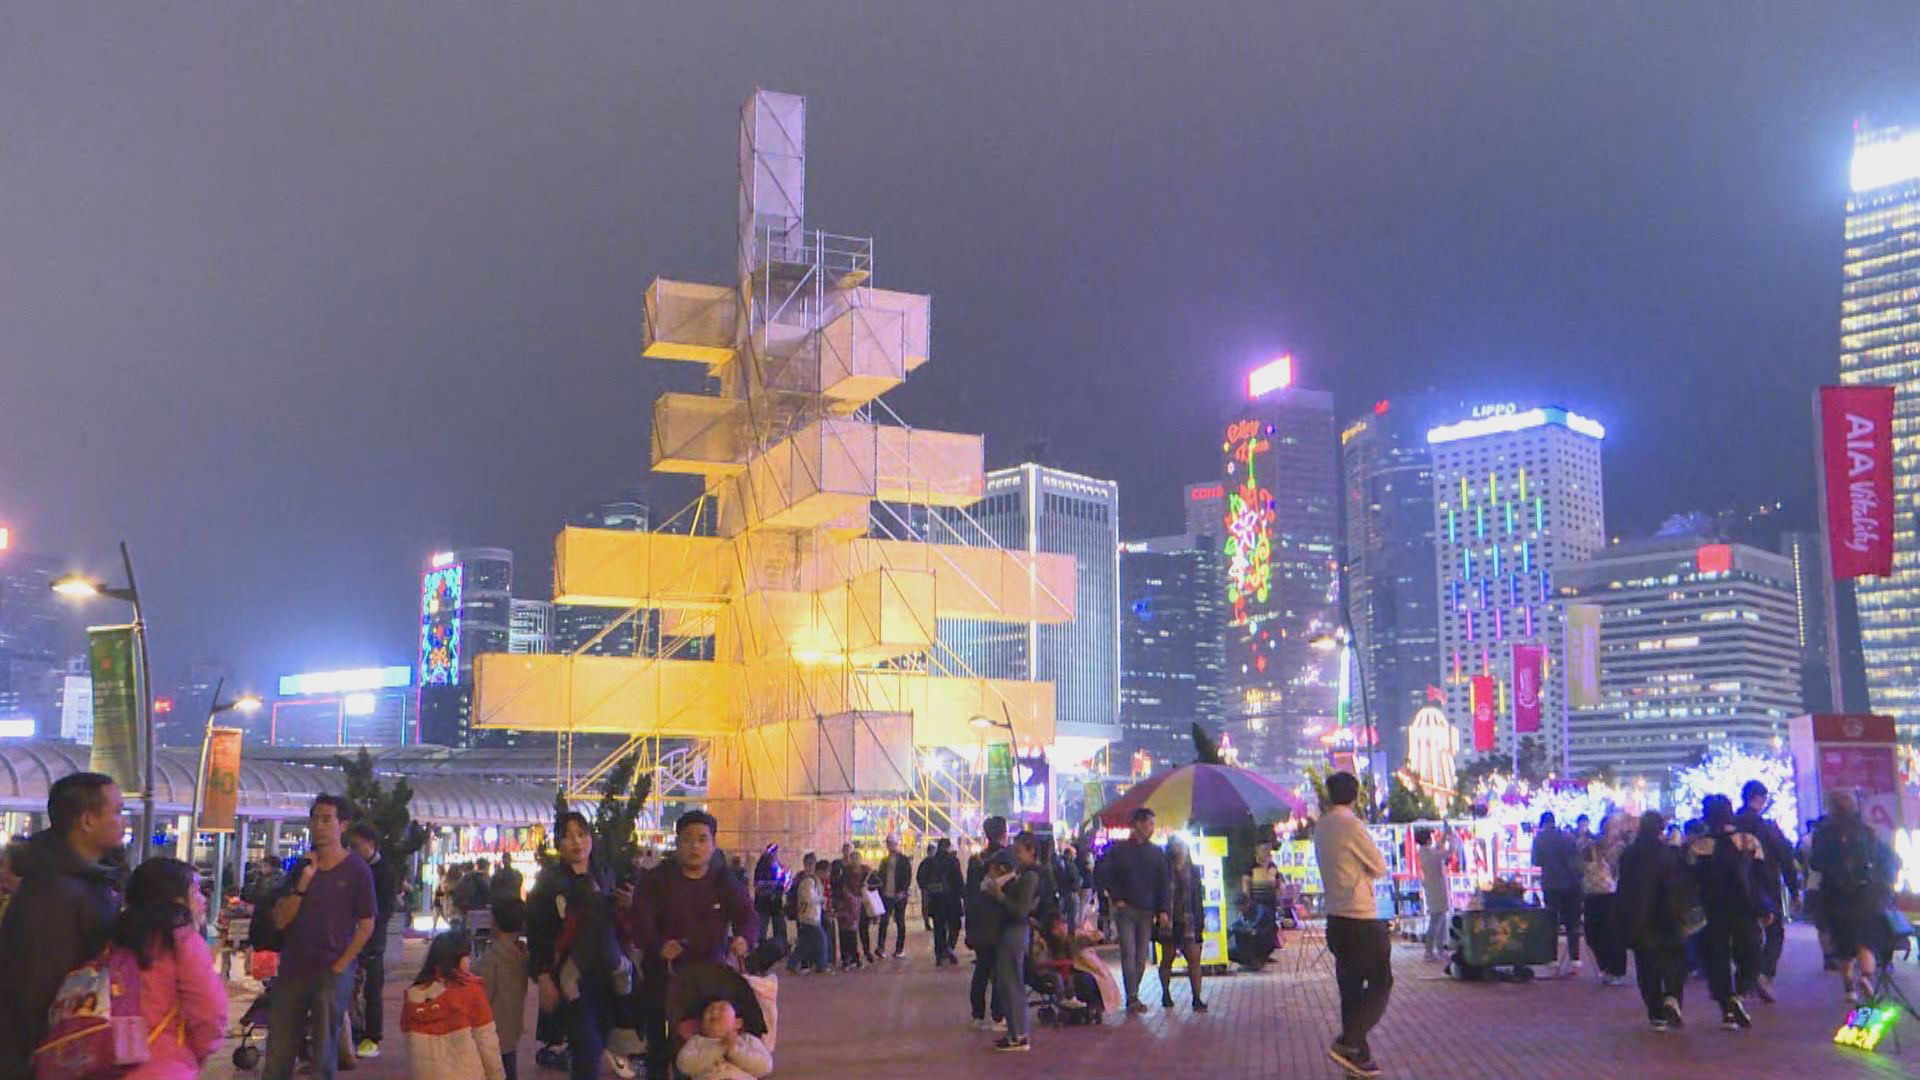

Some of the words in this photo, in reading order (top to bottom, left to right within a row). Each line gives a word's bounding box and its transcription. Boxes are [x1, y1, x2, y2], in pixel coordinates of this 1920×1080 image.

[1472, 402, 1517, 417] LIPPO
[1845, 413, 1875, 476] AIA
[1844, 480, 1881, 552] Vitality
